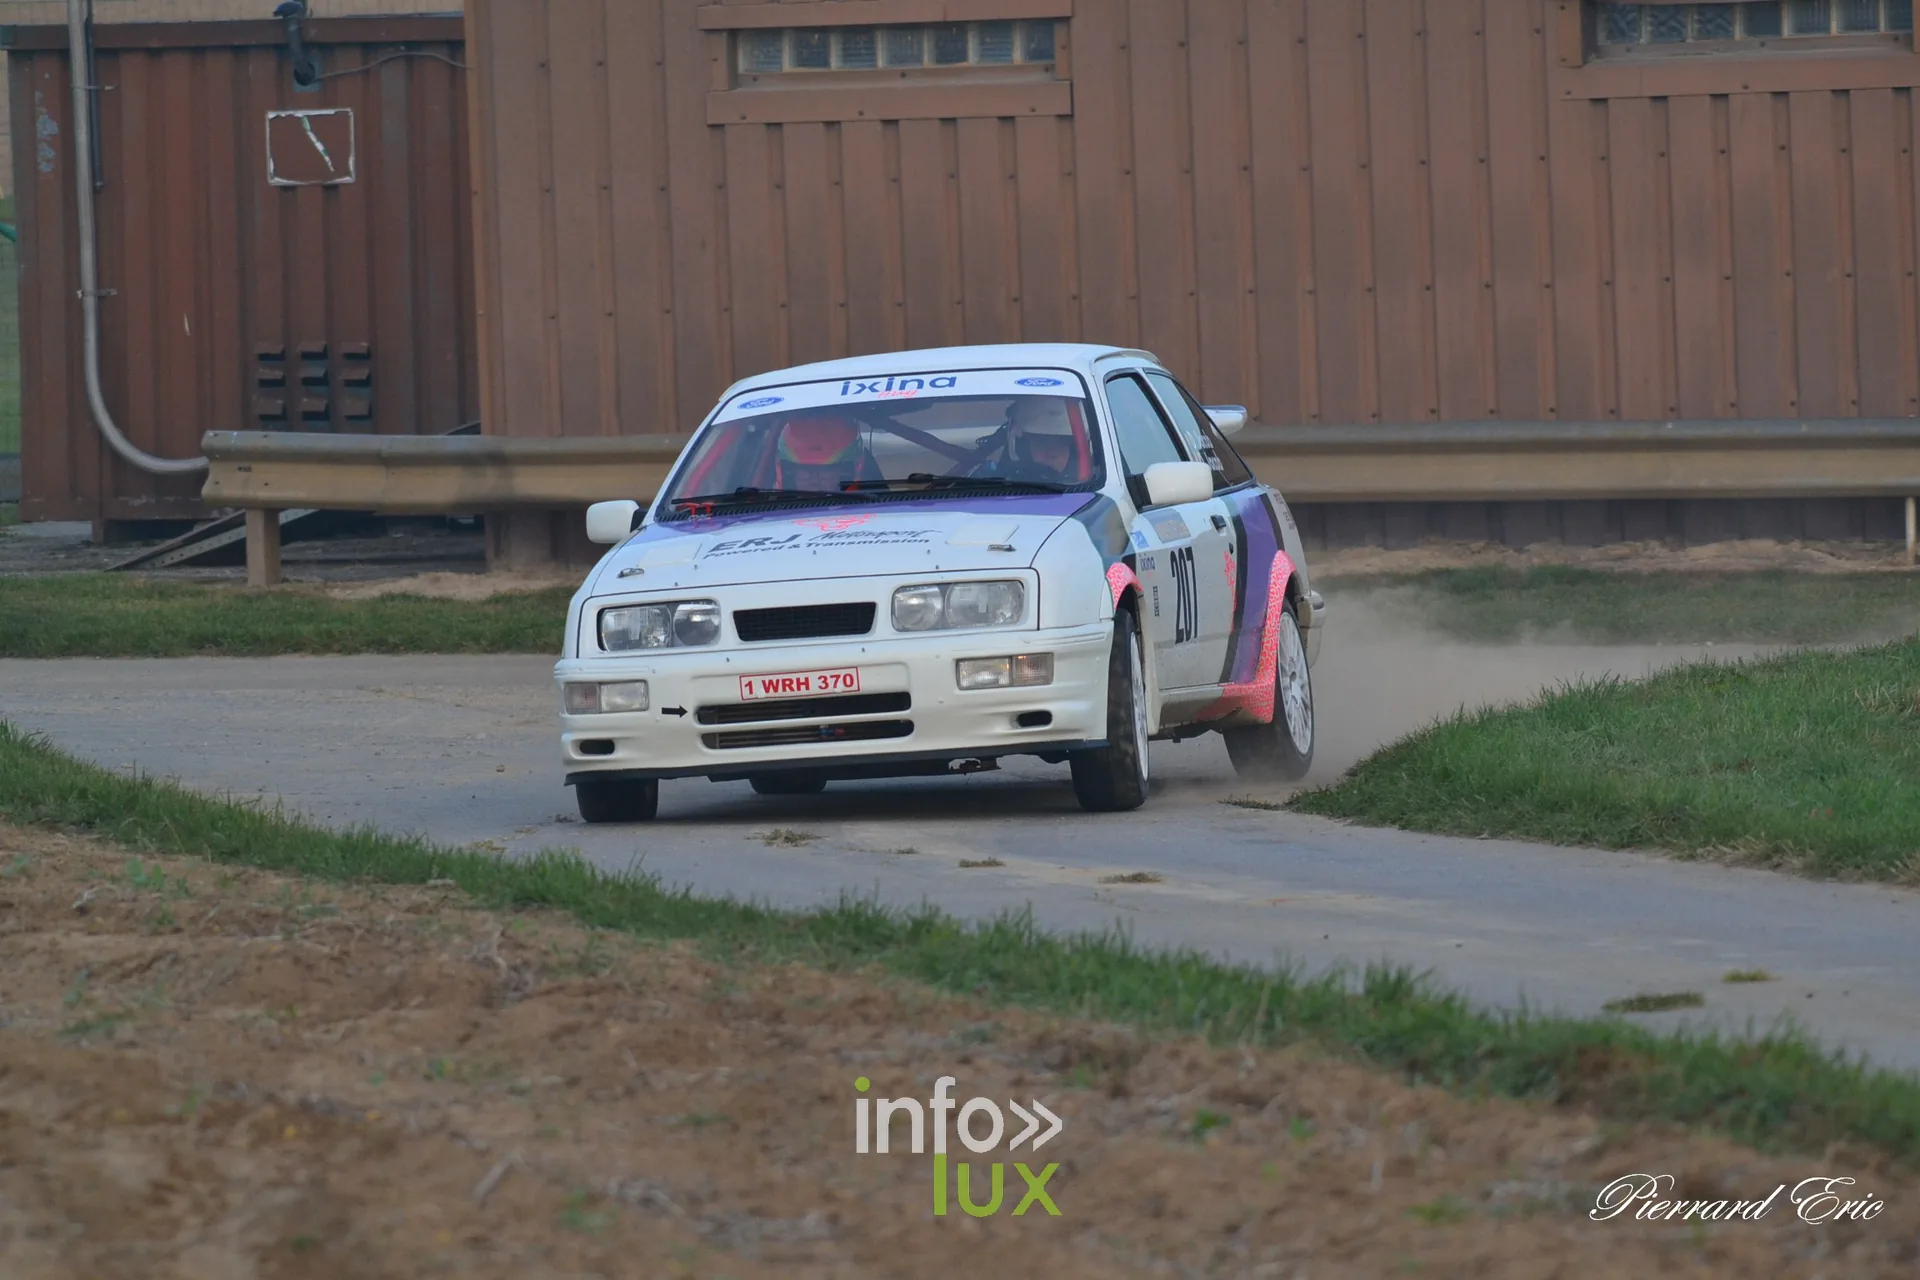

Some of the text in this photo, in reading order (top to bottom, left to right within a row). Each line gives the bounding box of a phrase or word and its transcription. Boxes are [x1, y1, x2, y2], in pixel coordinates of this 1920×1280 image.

[841, 376, 957, 396] ixina
[708, 534, 802, 553] ERJ
[806, 539, 930, 548] Transmission
[1170, 547, 1199, 644] 207
[745, 673, 855, 695] 1 WRH 370
